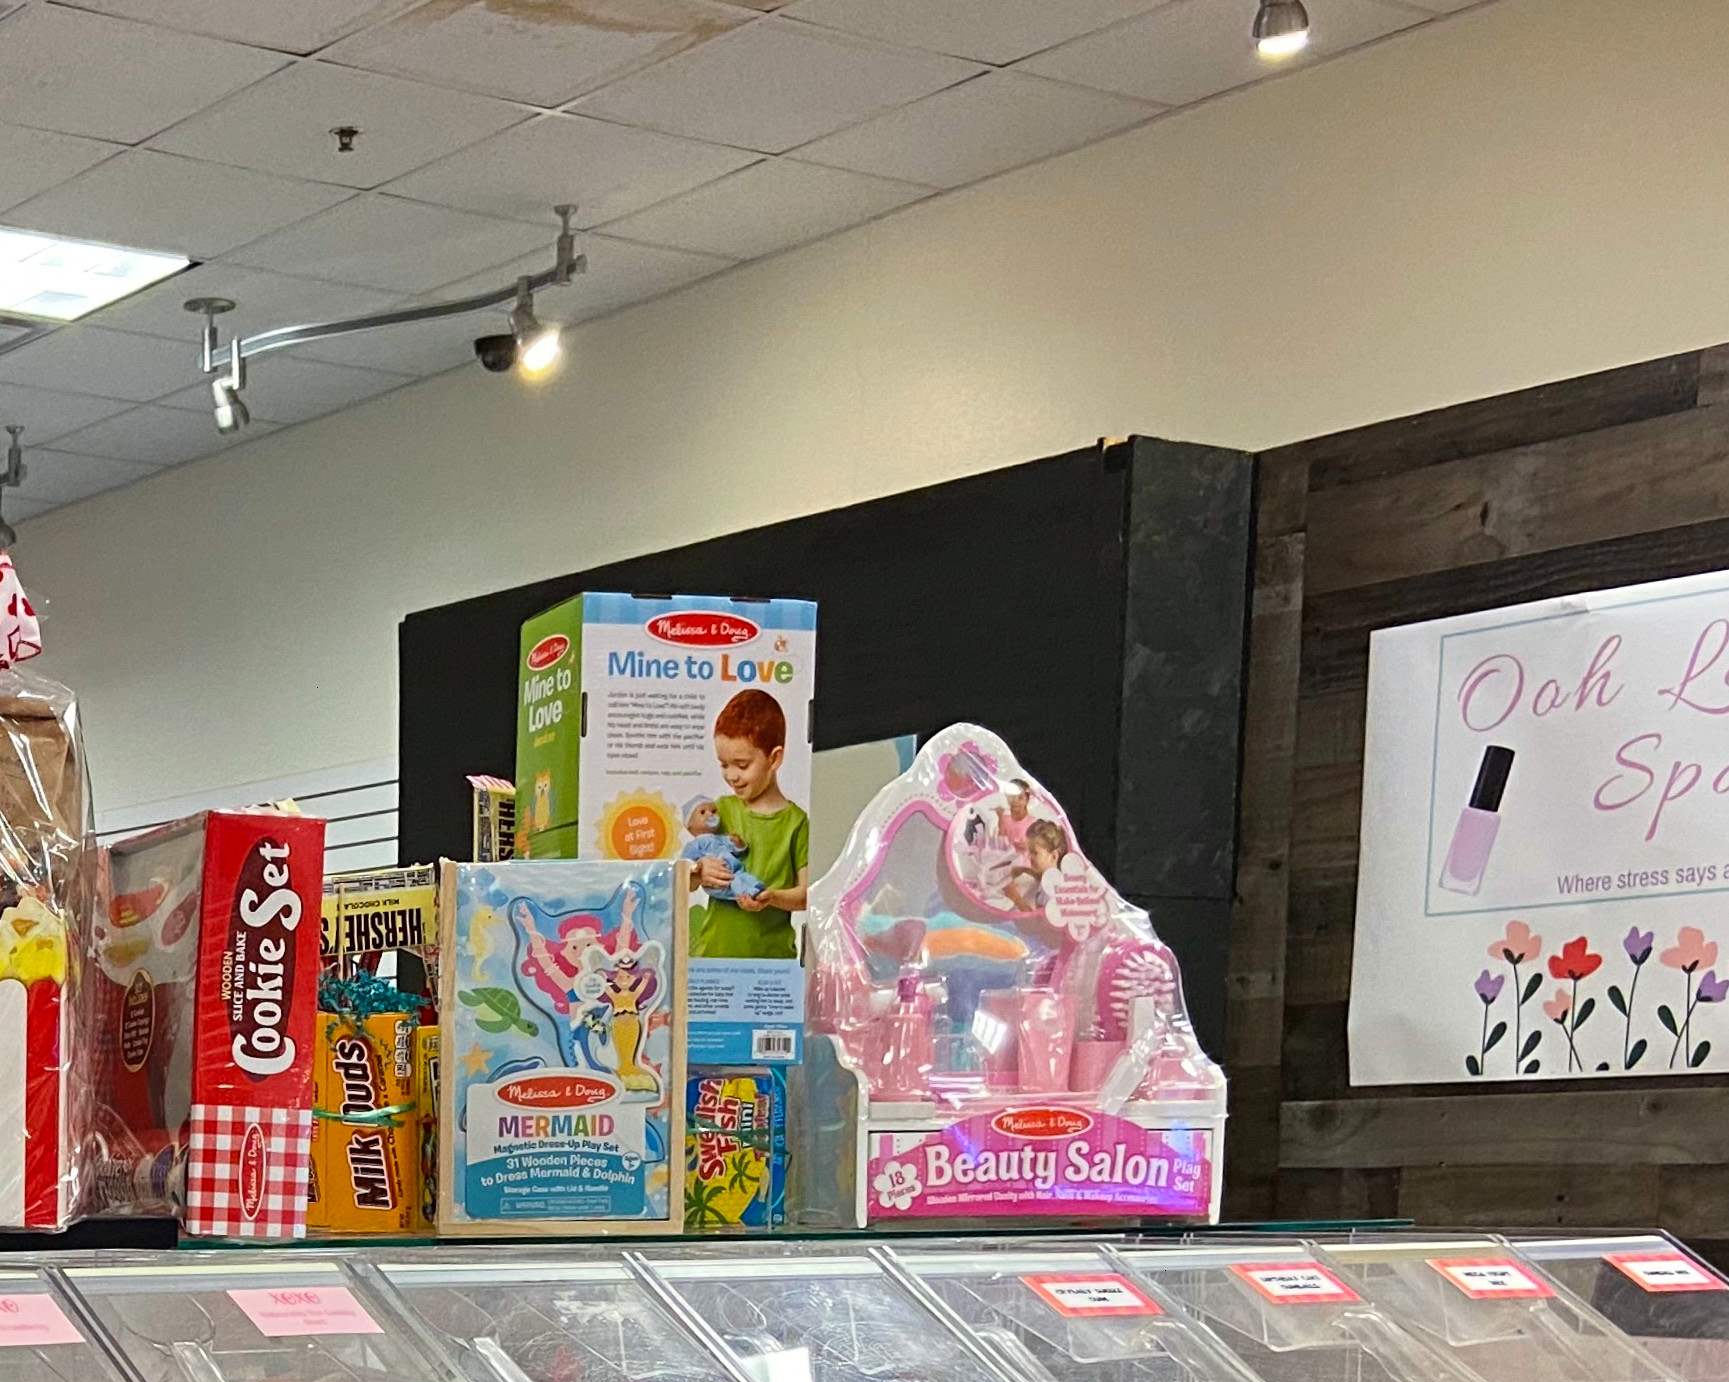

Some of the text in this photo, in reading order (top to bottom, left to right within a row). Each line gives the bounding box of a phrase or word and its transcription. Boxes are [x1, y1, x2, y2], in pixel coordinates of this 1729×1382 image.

[657, 619, 752, 643] Melissa Doug
[608, 651, 794, 685] Mine to Love
[523, 668, 571, 706] Mine to
[528, 700, 563, 733] Love
[1557, 864, 1717, 895] Where stress says
[232, 842, 302, 1075] Cookie Set
[221, 951, 234, 1001] WOODEN
[233, 930, 247, 1021] SLICE AND BAKE
[507, 1084, 607, 1103] Melissa Doug
[498, 1114, 615, 1138] MERMAID
[1002, 1115, 1084, 1133] Melissa Doug
[493, 1140, 619, 1155] Magnetic Dress-Up Play Set
[346, 1134, 393, 1211] Milk
[506, 1154, 608, 1170] 31 Wooden Pieces
[924, 1141, 1170, 1189] Beauty Salon
[1173, 1157, 1201, 1180] Play
[480, 1166, 636, 1187] to Dress Mermaid & Dolphin
[888, 1171, 904, 1187] 18
[1174, 1177, 1196, 1193] Set
[887, 1184, 917, 1202] Pieces
